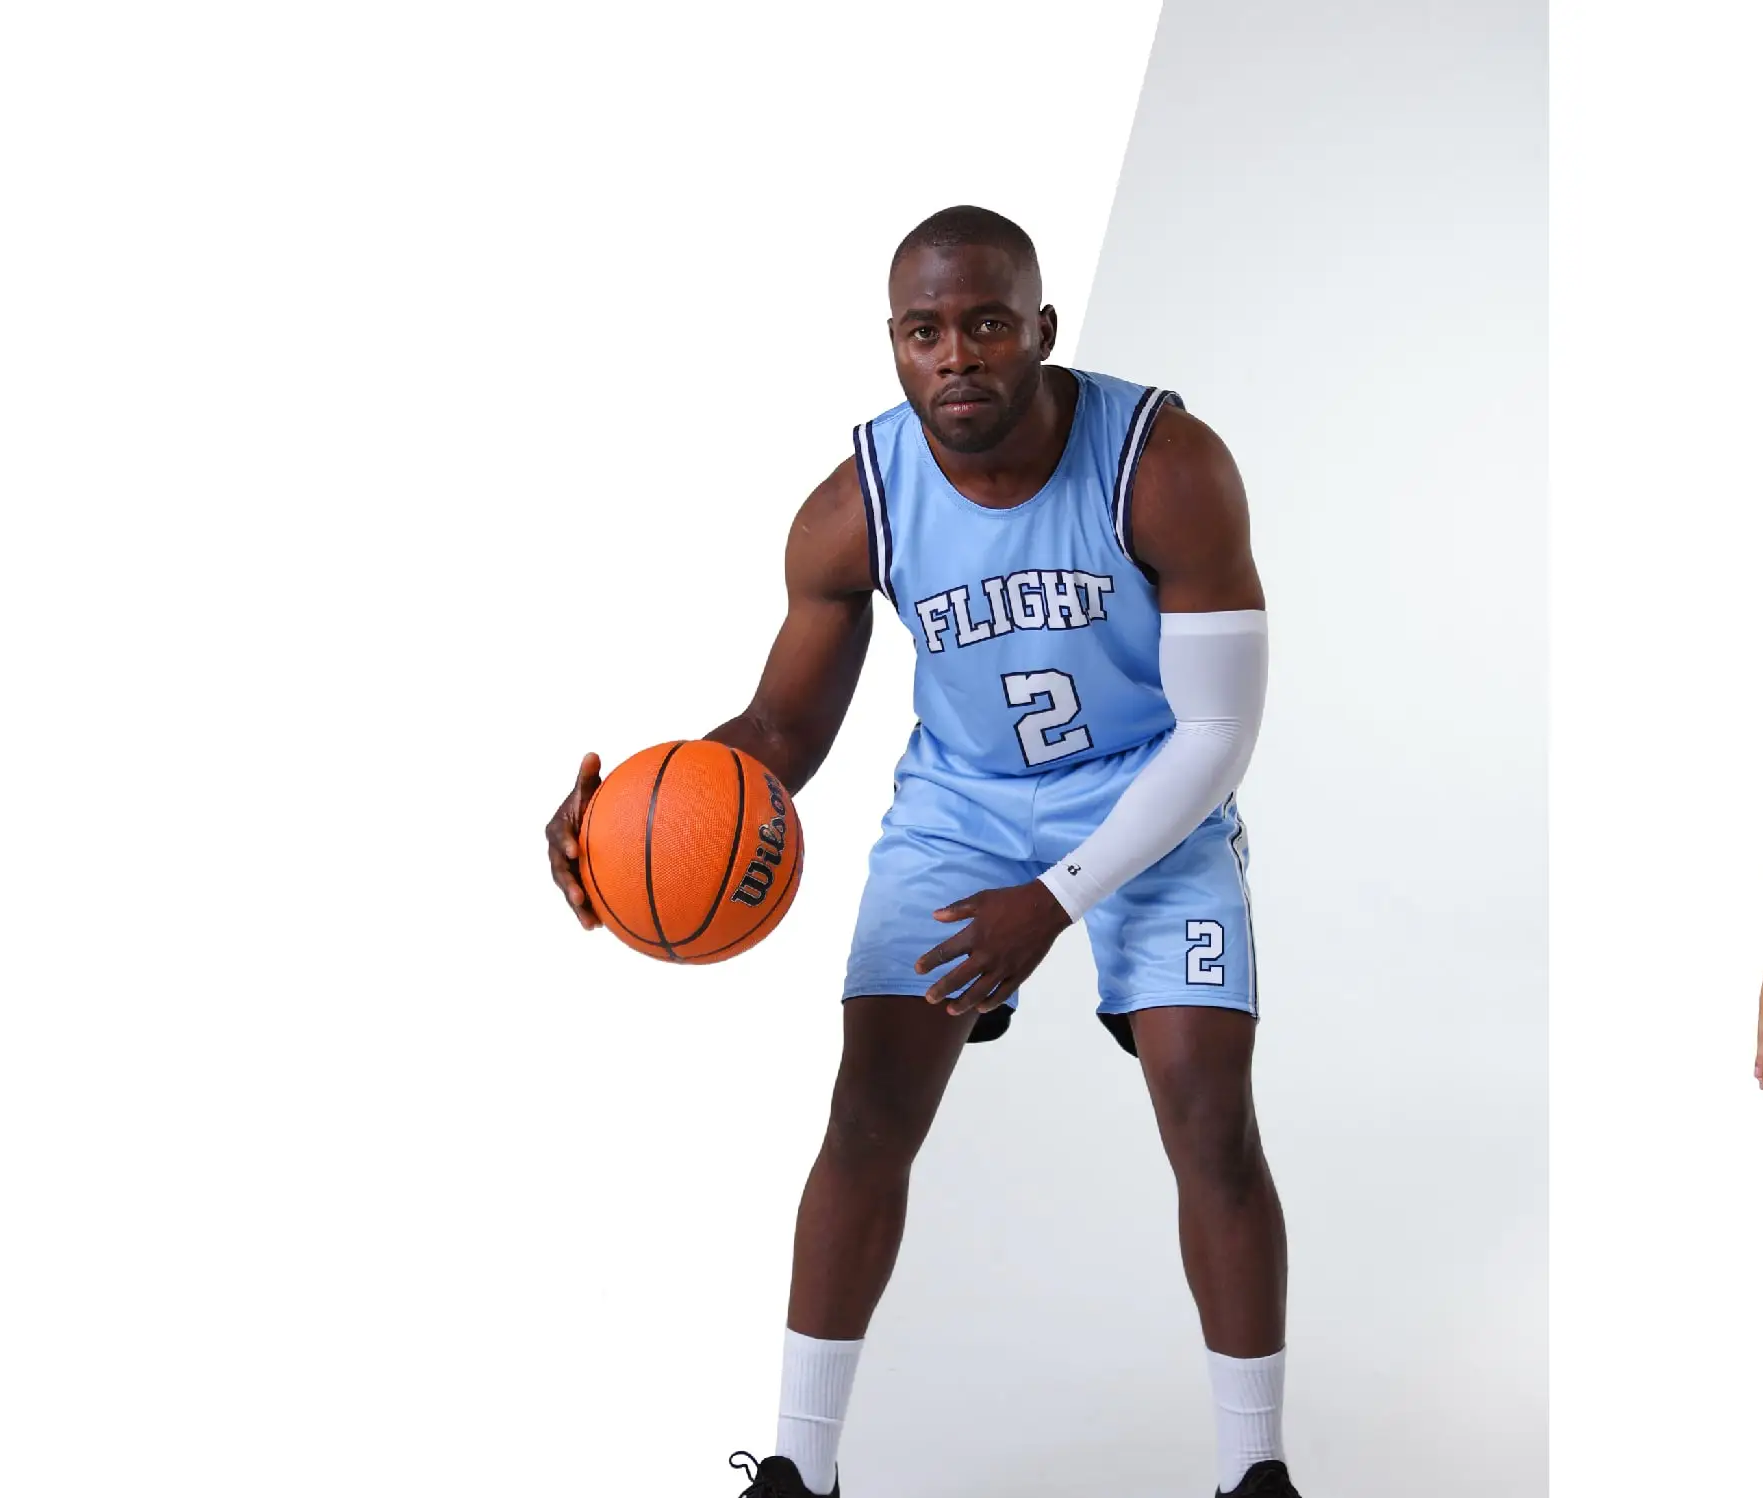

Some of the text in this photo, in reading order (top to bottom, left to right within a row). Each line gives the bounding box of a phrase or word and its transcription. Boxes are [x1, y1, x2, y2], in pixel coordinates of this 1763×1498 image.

[914, 569, 1115, 653] FLIGHT
[1000, 668, 1094, 768] 2
[731, 772, 786, 907] Wilson
[1186, 920, 1225, 987] 2
